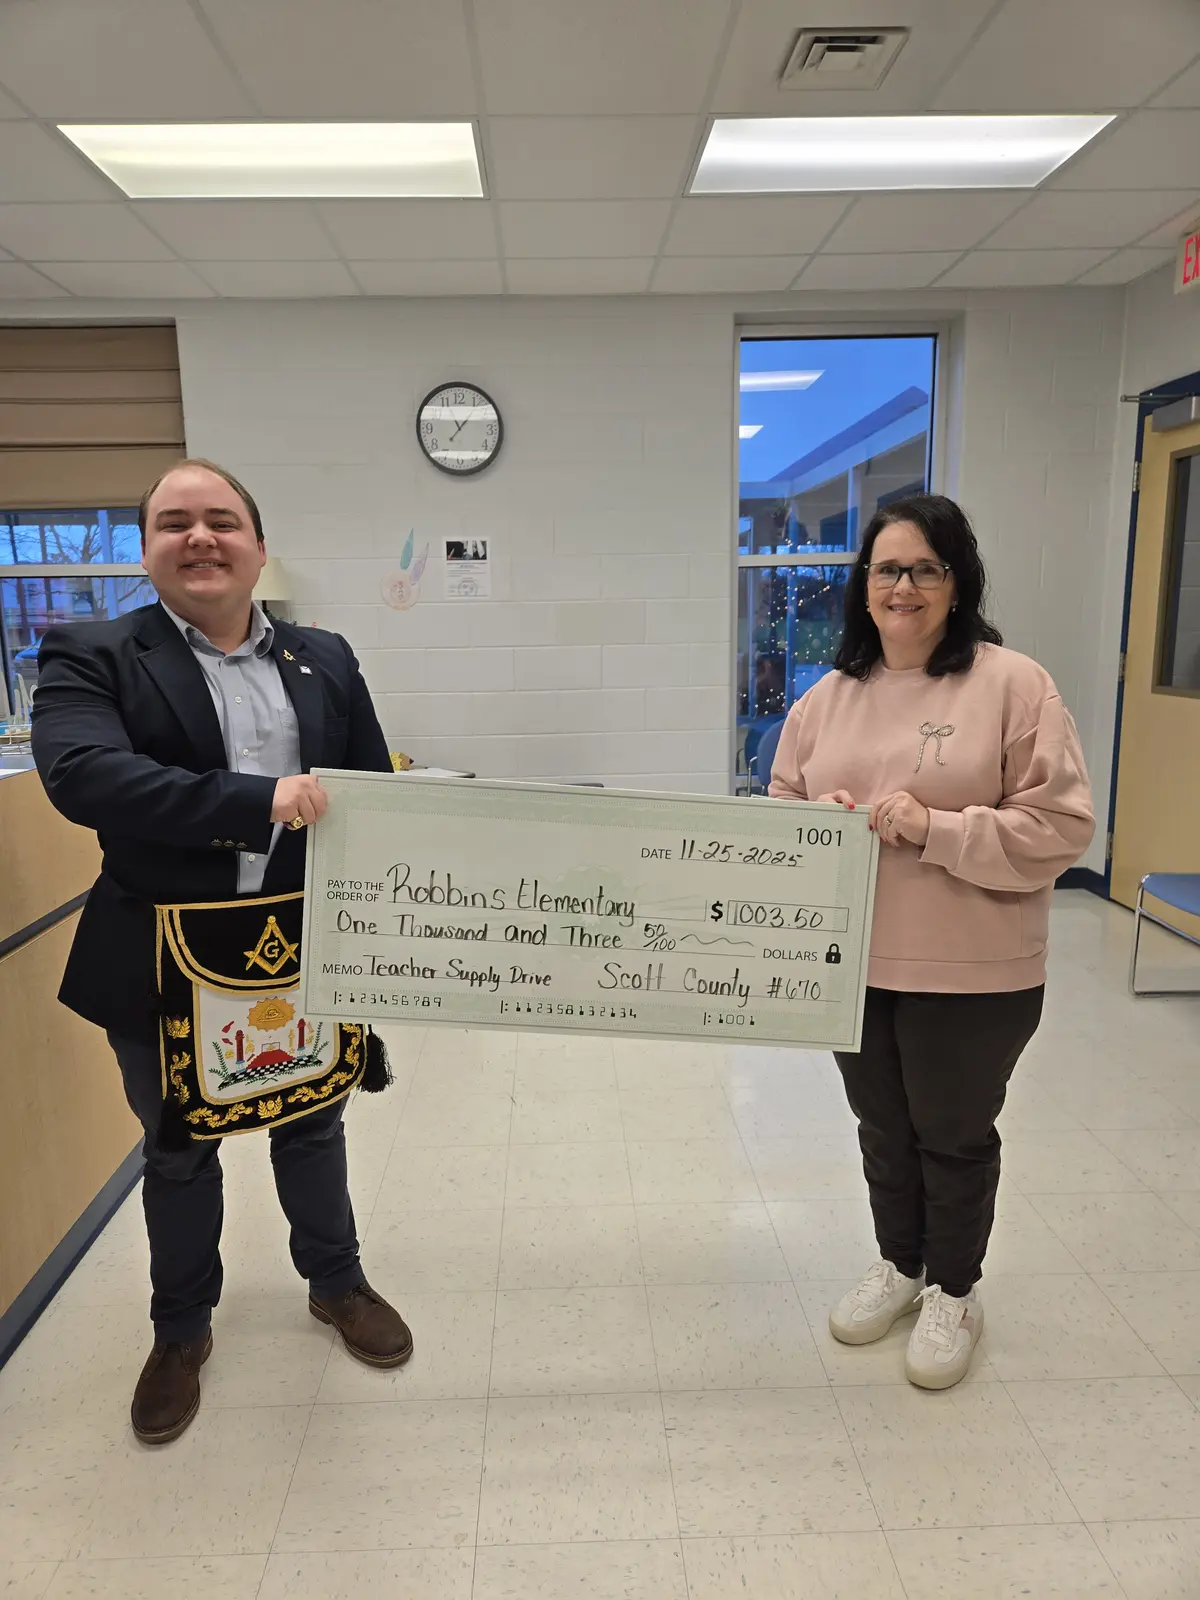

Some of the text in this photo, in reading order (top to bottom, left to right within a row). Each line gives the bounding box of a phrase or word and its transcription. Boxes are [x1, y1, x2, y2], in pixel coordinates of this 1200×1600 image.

[441, 397, 449, 407] 11
[453, 392, 465, 405] 12
[425, 422, 433, 435] 9
[486, 423, 494, 436] 3
[431, 438, 438, 450] 8
[481, 438, 488, 451] 4
[796, 827, 843, 847] 1001
[640, 847, 672, 860] DATE
[327, 879, 384, 892] PAY TO THE
[326, 890, 380, 902] ORDER OF
[386, 862, 635, 927] Robbins Elementary
[710, 901, 824, 929] $ 1003.50
[337, 909, 378, 935] One
[393, 913, 489, 942] Thousand
[504, 923, 548, 946] and
[560, 925, 623, 949] Three
[264, 939, 280, 958] G
[763, 948, 818, 962] DOLLARS
[322, 963, 363, 976] MEMO
[363, 954, 552, 993] Teacher Supply Drive
[597, 961, 822, 1008] Scott County #670
